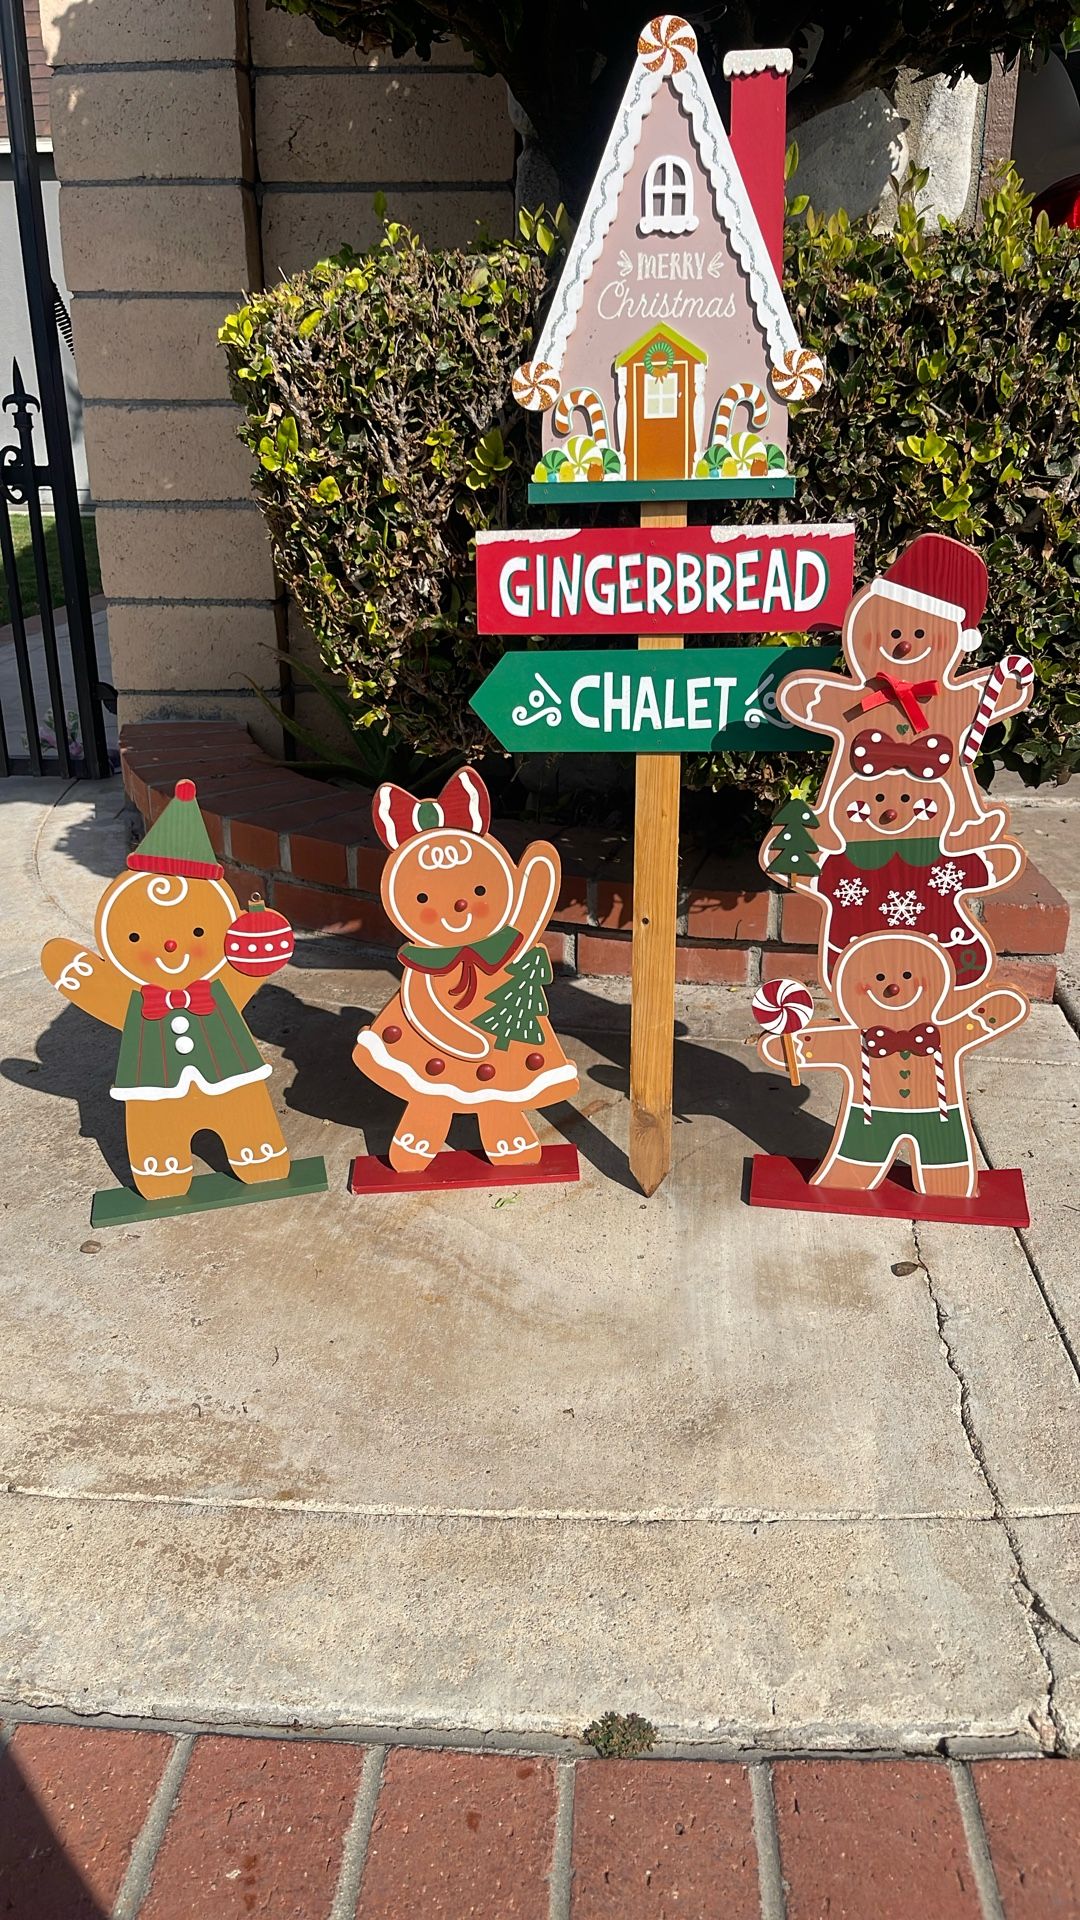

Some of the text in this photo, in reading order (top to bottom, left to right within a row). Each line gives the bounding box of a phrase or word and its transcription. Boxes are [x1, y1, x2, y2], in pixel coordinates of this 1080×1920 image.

[636, 251, 706, 281] MERRY
[597, 279, 737, 320] Christmas
[499, 548, 830, 618] GINGERBREAD
[569, 671, 738, 732] CHALET
